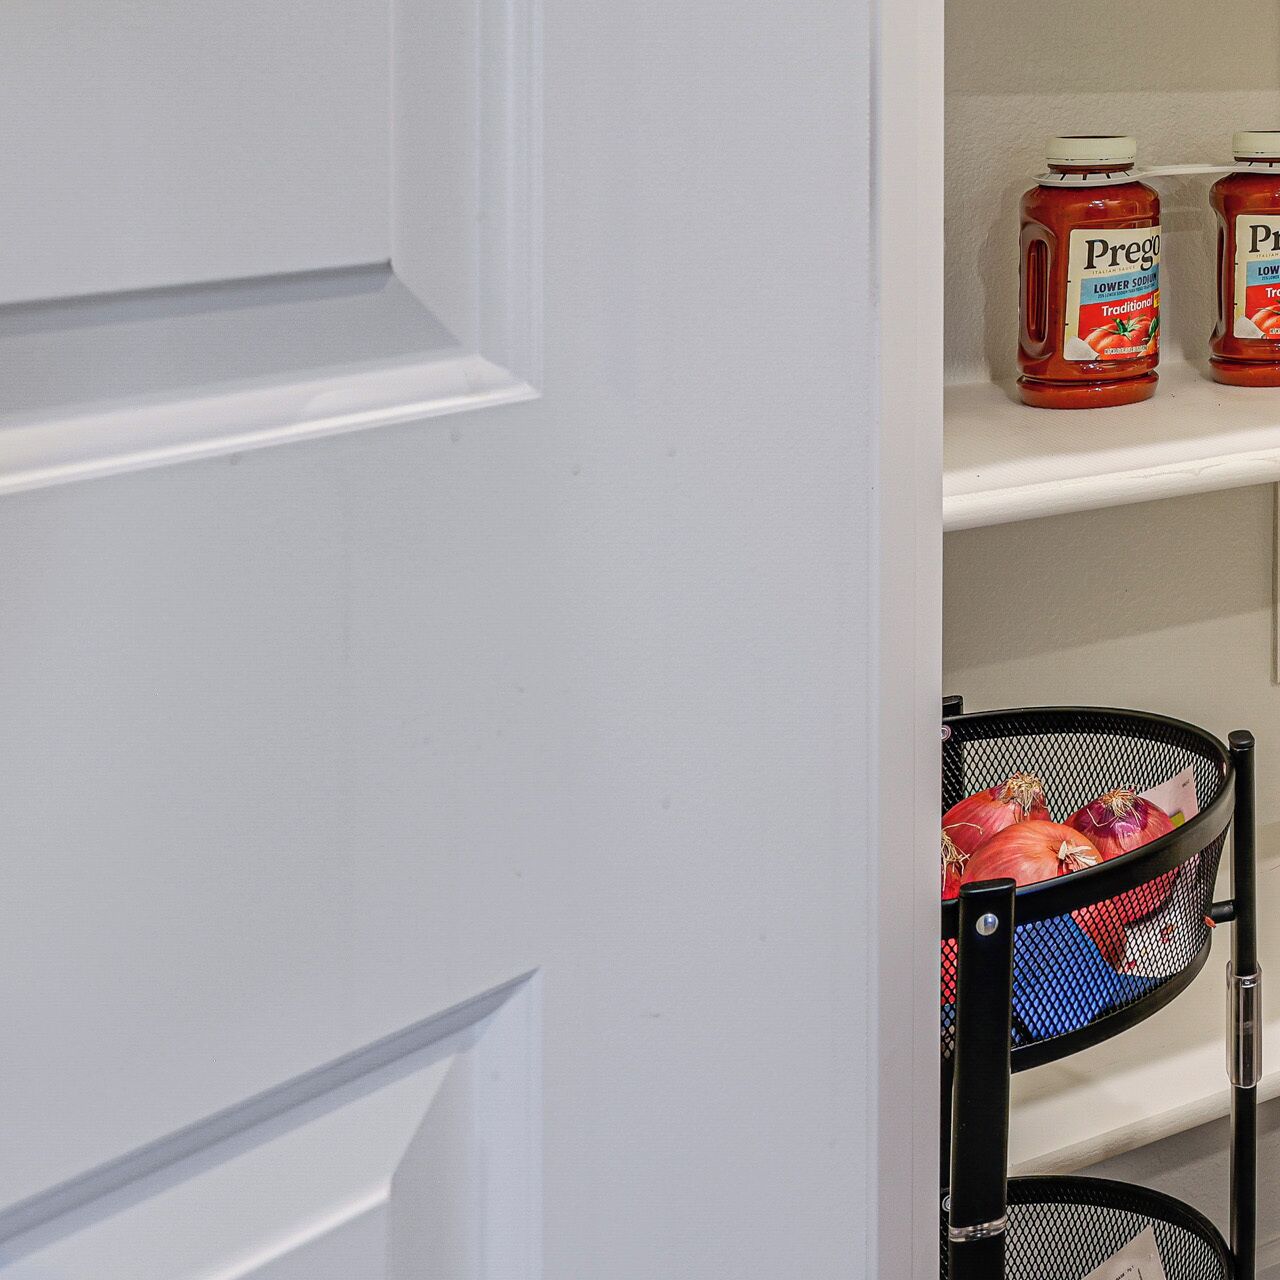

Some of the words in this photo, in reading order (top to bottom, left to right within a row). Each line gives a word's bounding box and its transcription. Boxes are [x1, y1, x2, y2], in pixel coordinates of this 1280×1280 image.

[1083, 234, 1160, 271] Prego
[1093, 280, 1129, 294] LOWER
[1101, 297, 1153, 317] Traditional
